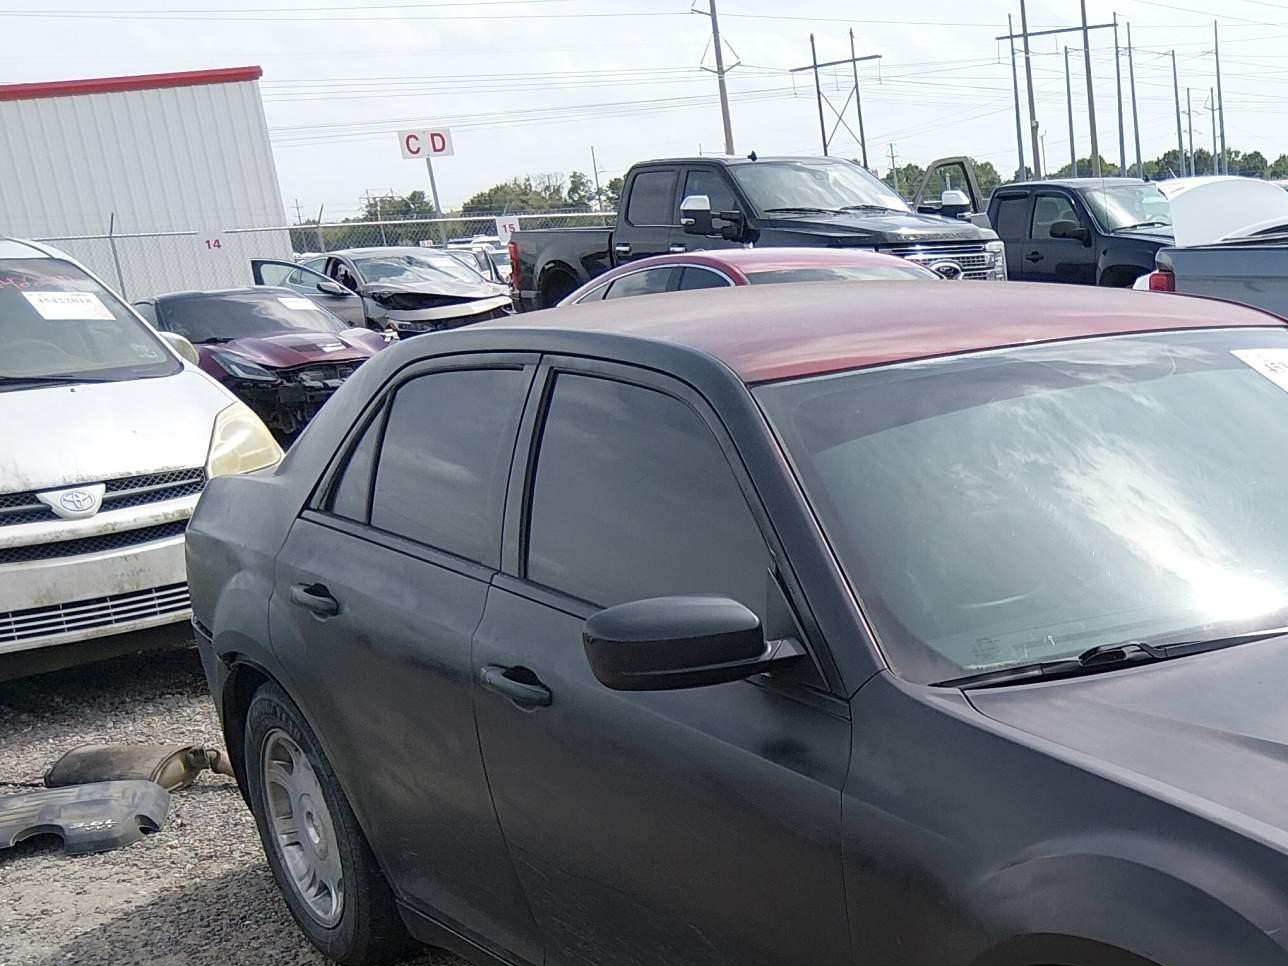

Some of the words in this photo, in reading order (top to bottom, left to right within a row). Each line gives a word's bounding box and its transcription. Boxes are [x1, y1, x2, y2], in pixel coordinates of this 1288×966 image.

[405, 134, 421, 155] C
[430, 132, 446, 153] D
[503, 223, 516, 233] 15
[204, 239, 222, 250] 14
